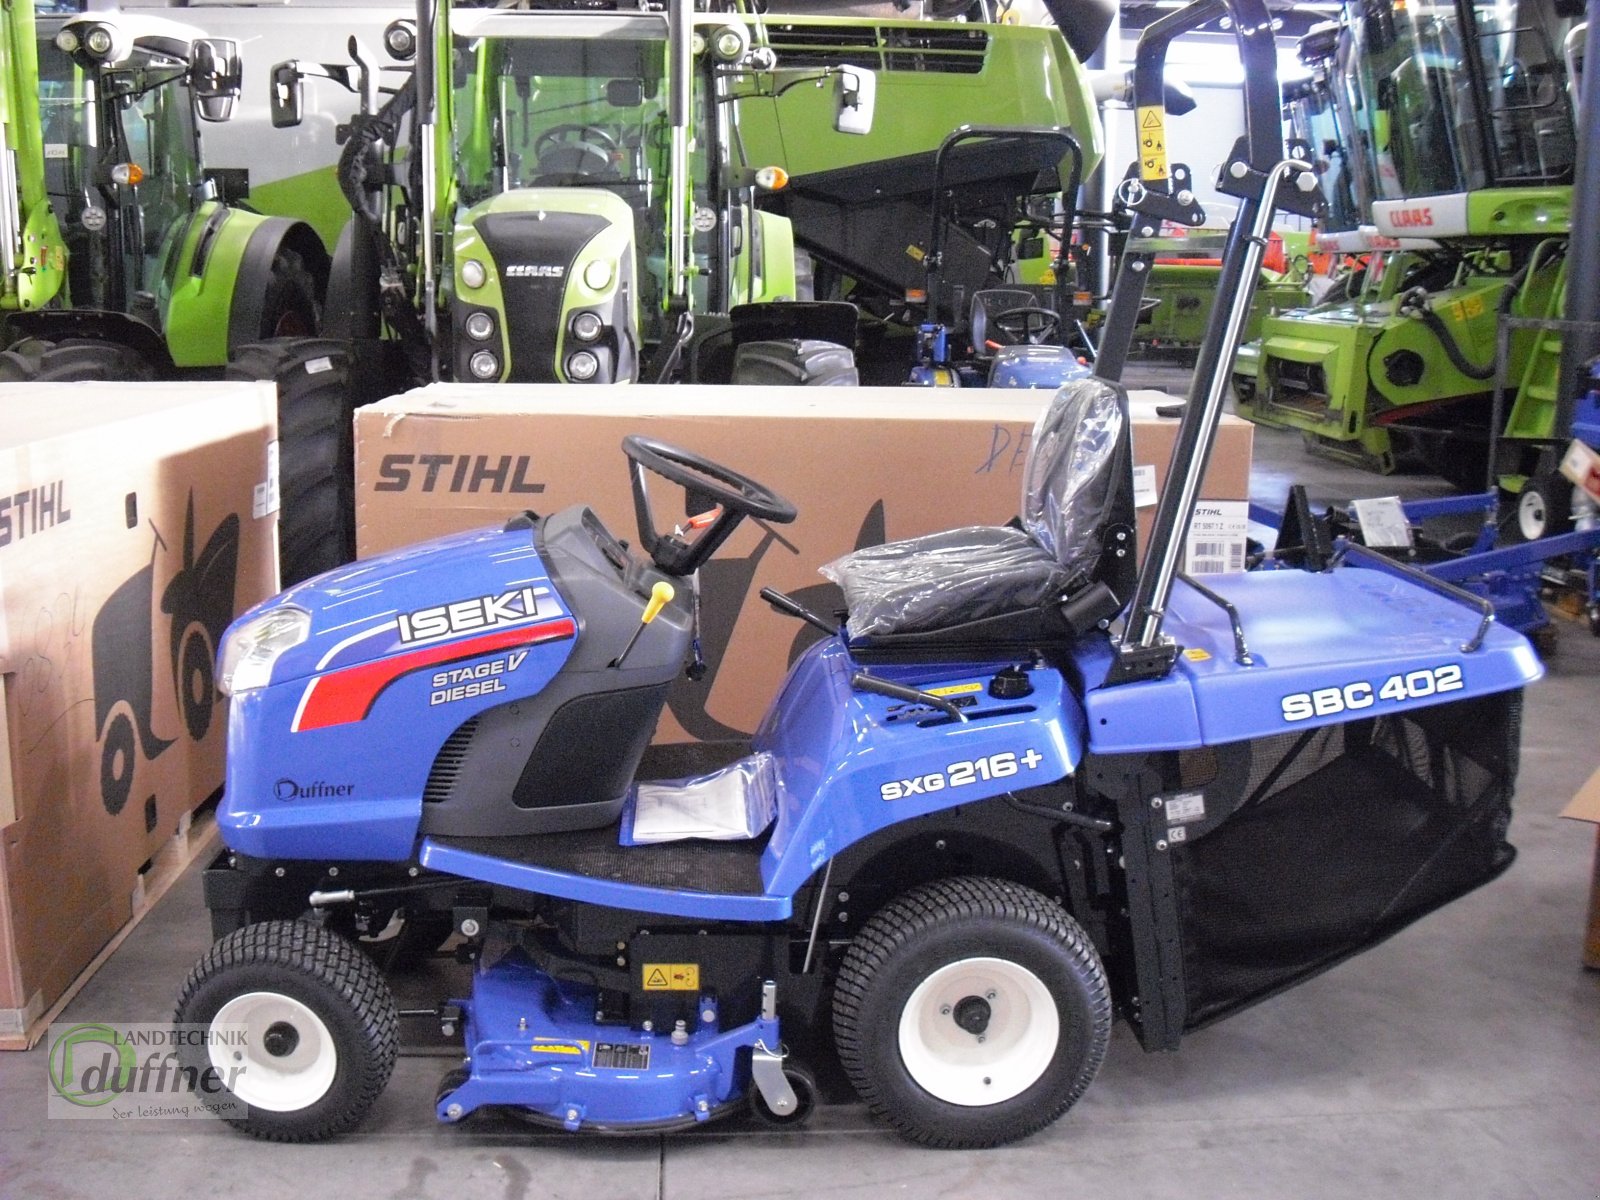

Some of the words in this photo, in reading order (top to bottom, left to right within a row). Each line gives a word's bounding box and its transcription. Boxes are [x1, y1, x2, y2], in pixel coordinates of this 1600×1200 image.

[1390, 207, 1433, 228] CLAAS
[374, 454, 546, 494] STIHL
[0, 480, 71, 548] STIHL
[397, 586, 538, 644] ISEKI
[432, 660, 505, 689] STAGE
[507, 650, 530, 672] V
[429, 678, 507, 707] DIESEL
[1281, 682, 1375, 722] SBC
[1378, 664, 1465, 702] 402
[880, 773, 945, 801] SXG
